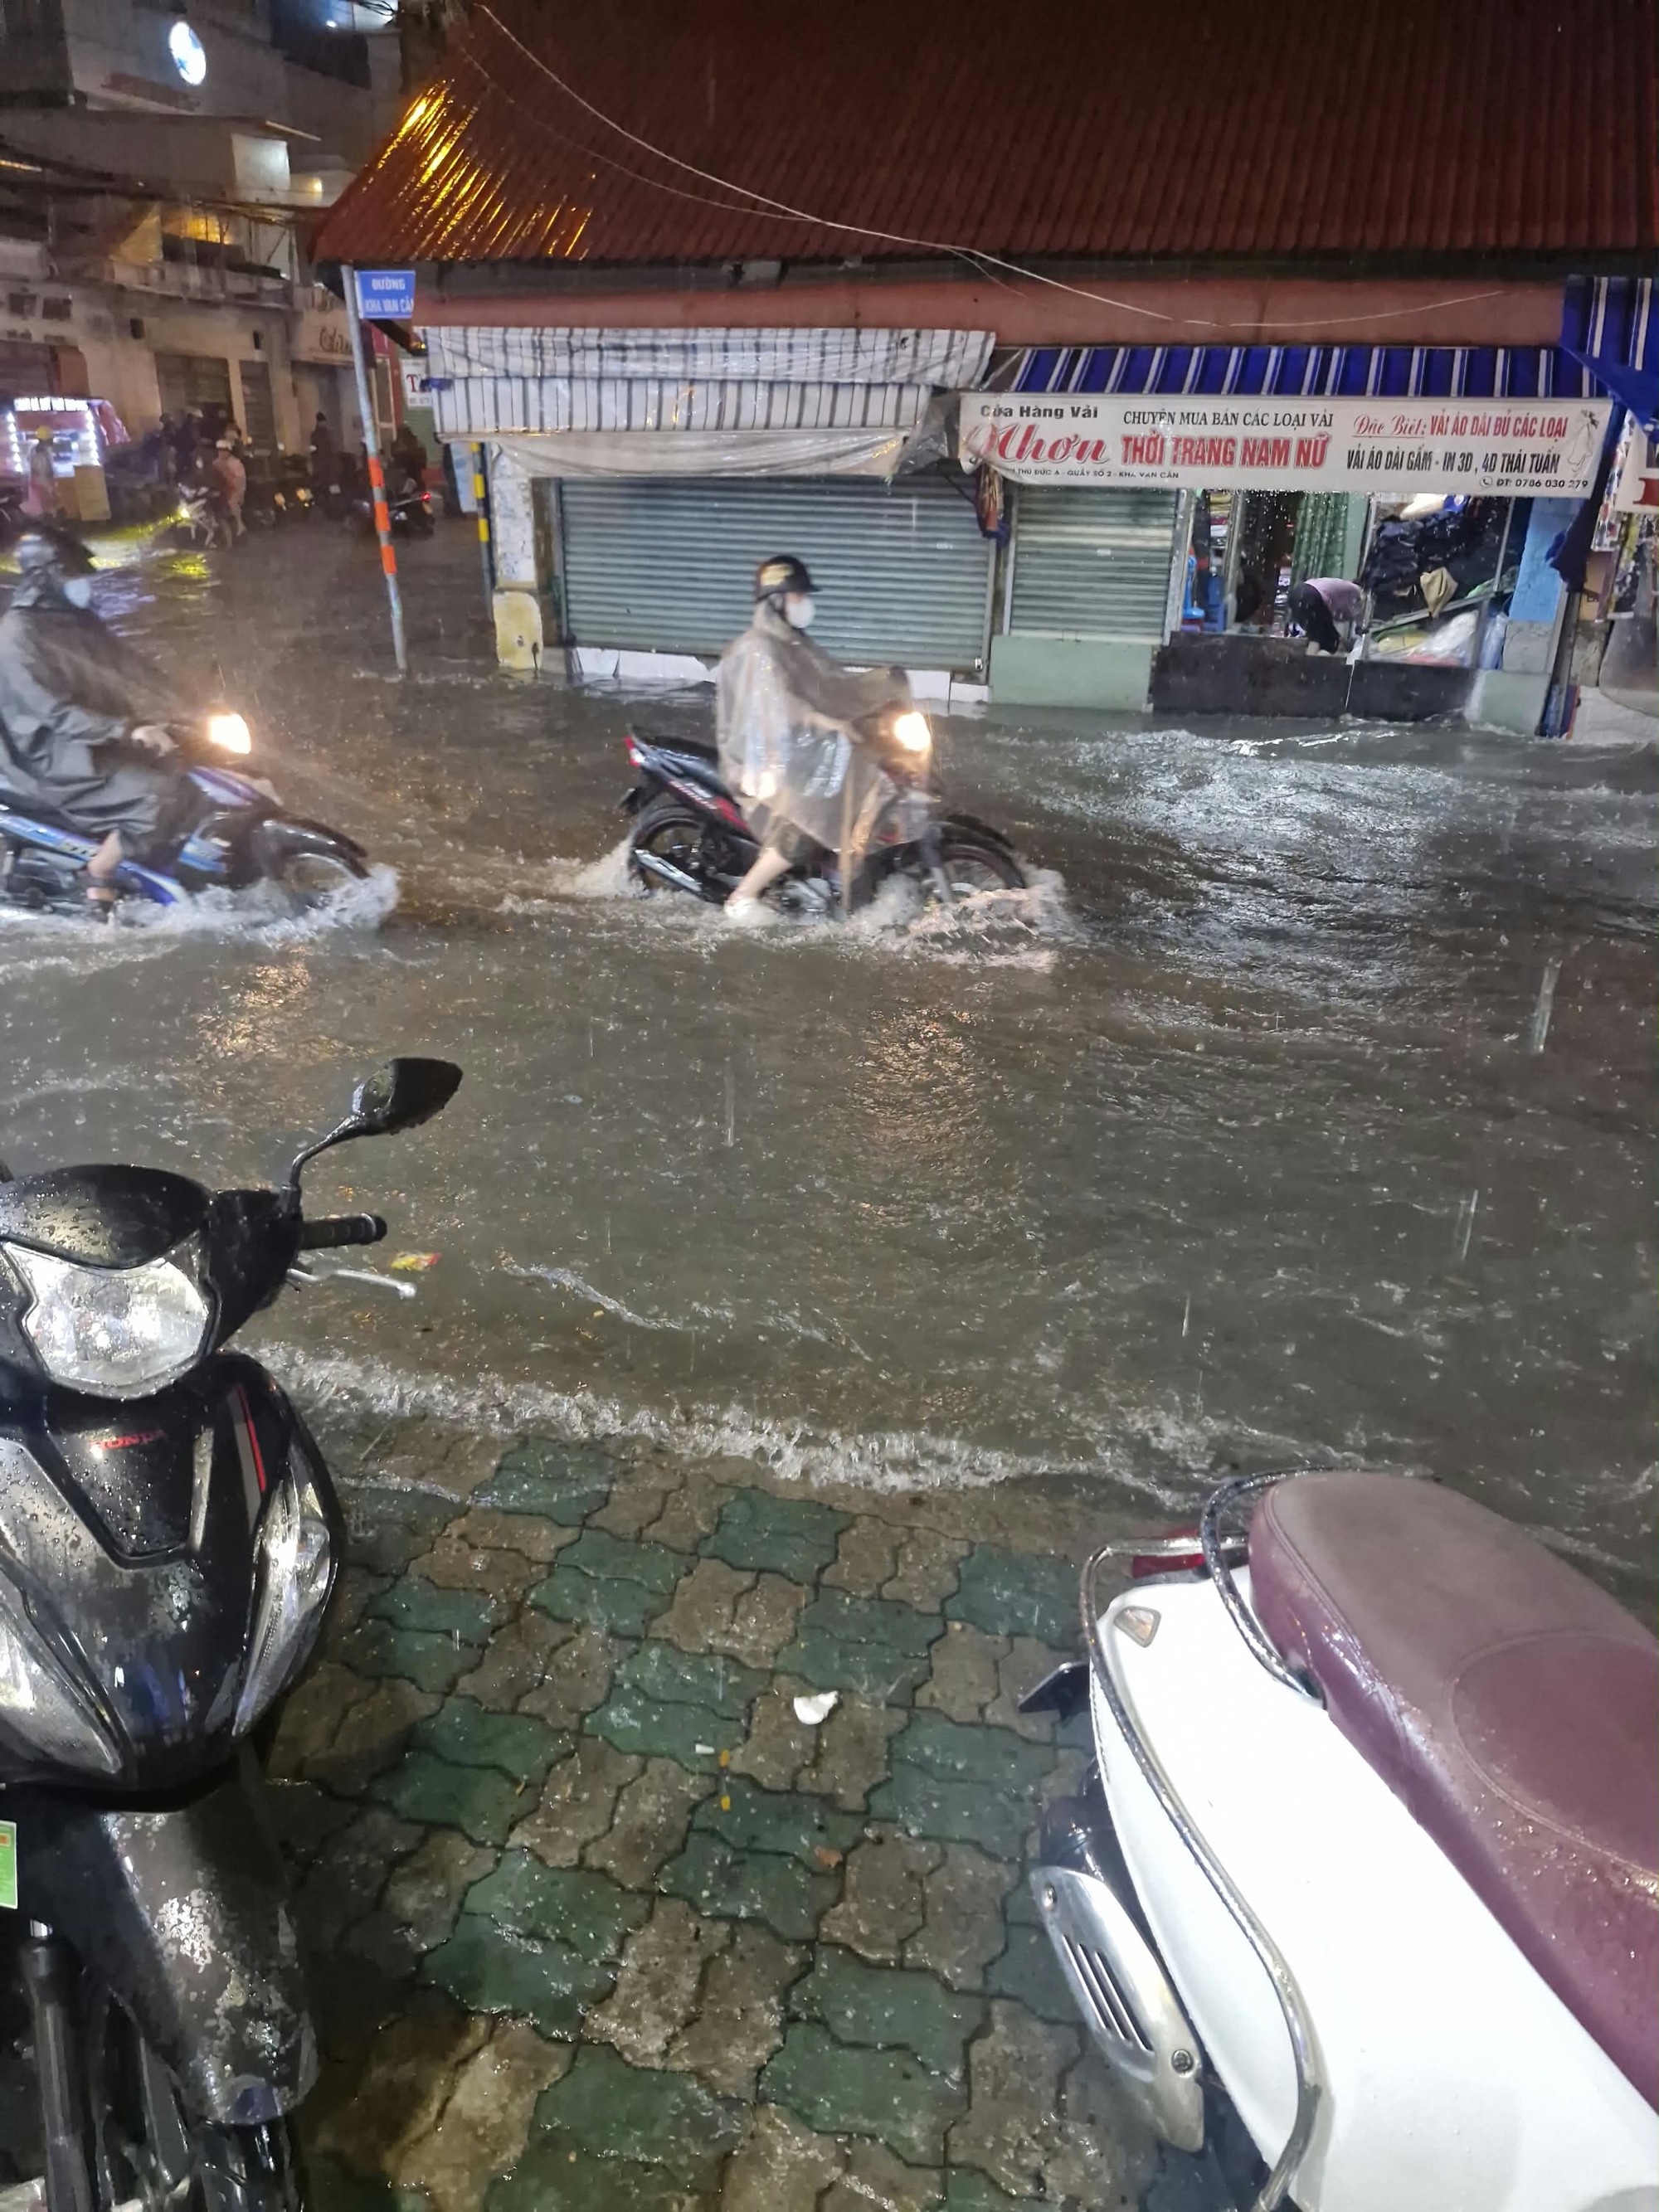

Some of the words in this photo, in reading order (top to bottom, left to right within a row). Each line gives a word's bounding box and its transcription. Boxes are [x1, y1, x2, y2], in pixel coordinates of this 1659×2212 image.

[371, 276, 406, 290] ĐƯỜNG
[365, 299, 382, 313] KHA
[1019, 405, 1063, 419] Hàng
[1071, 405, 1097, 418] Vải
[1123, 409, 1176, 426] CHUYÊN
[1179, 412, 1208, 426] MUA
[1212, 408, 1239, 426] BÁN
[1243, 408, 1269, 427] CÁC
[1273, 413, 1305, 430] LOẠI
[1311, 409, 1334, 427] VẢI
[1430, 408, 1449, 435] VẢI
[1451, 411, 1467, 436] ÁO
[1470, 412, 1490, 437] DÀI
[1494, 410, 1511, 437] ĐỦ
[1513, 412, 1536, 438] CÁC
[1539, 416, 1568, 442] LOẠI
[1121, 429, 1166, 467] THỜI
[1171, 434, 1238, 468] TRANG
[1240, 436, 1291, 469] NAM
[1294, 431, 1332, 470] NỮ
[1346, 443, 1365, 469] VẢI
[1366, 445, 1383, 469] ÁO
[1384, 445, 1404, 470] DÀI
[1442, 452, 1456, 472] IN
[1481, 453, 1496, 473] 4D
[1500, 449, 1524, 474] THÁI
[1528, 446, 1560, 474] TUẤN
[1515, 479, 1542, 488] 0786
[1545, 479, 1565, 488] 030
[1568, 480, 1588, 489] 279
